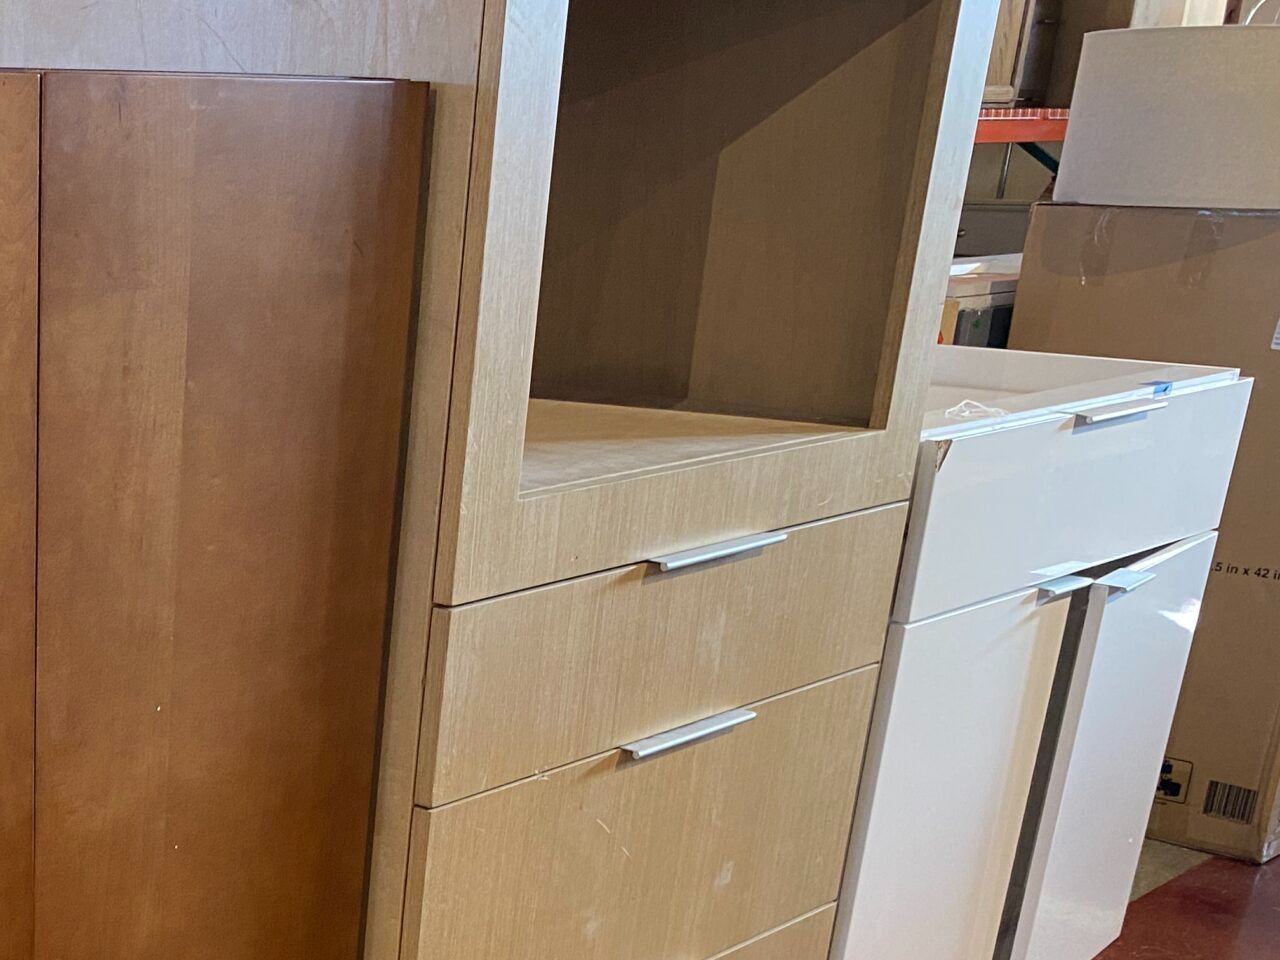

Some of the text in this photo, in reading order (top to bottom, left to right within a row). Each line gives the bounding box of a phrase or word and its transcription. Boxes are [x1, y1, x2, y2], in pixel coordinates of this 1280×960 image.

[1226, 563, 1239, 575] in
[1242, 567, 1250, 576] x
[1254, 567, 1270, 579] 42
